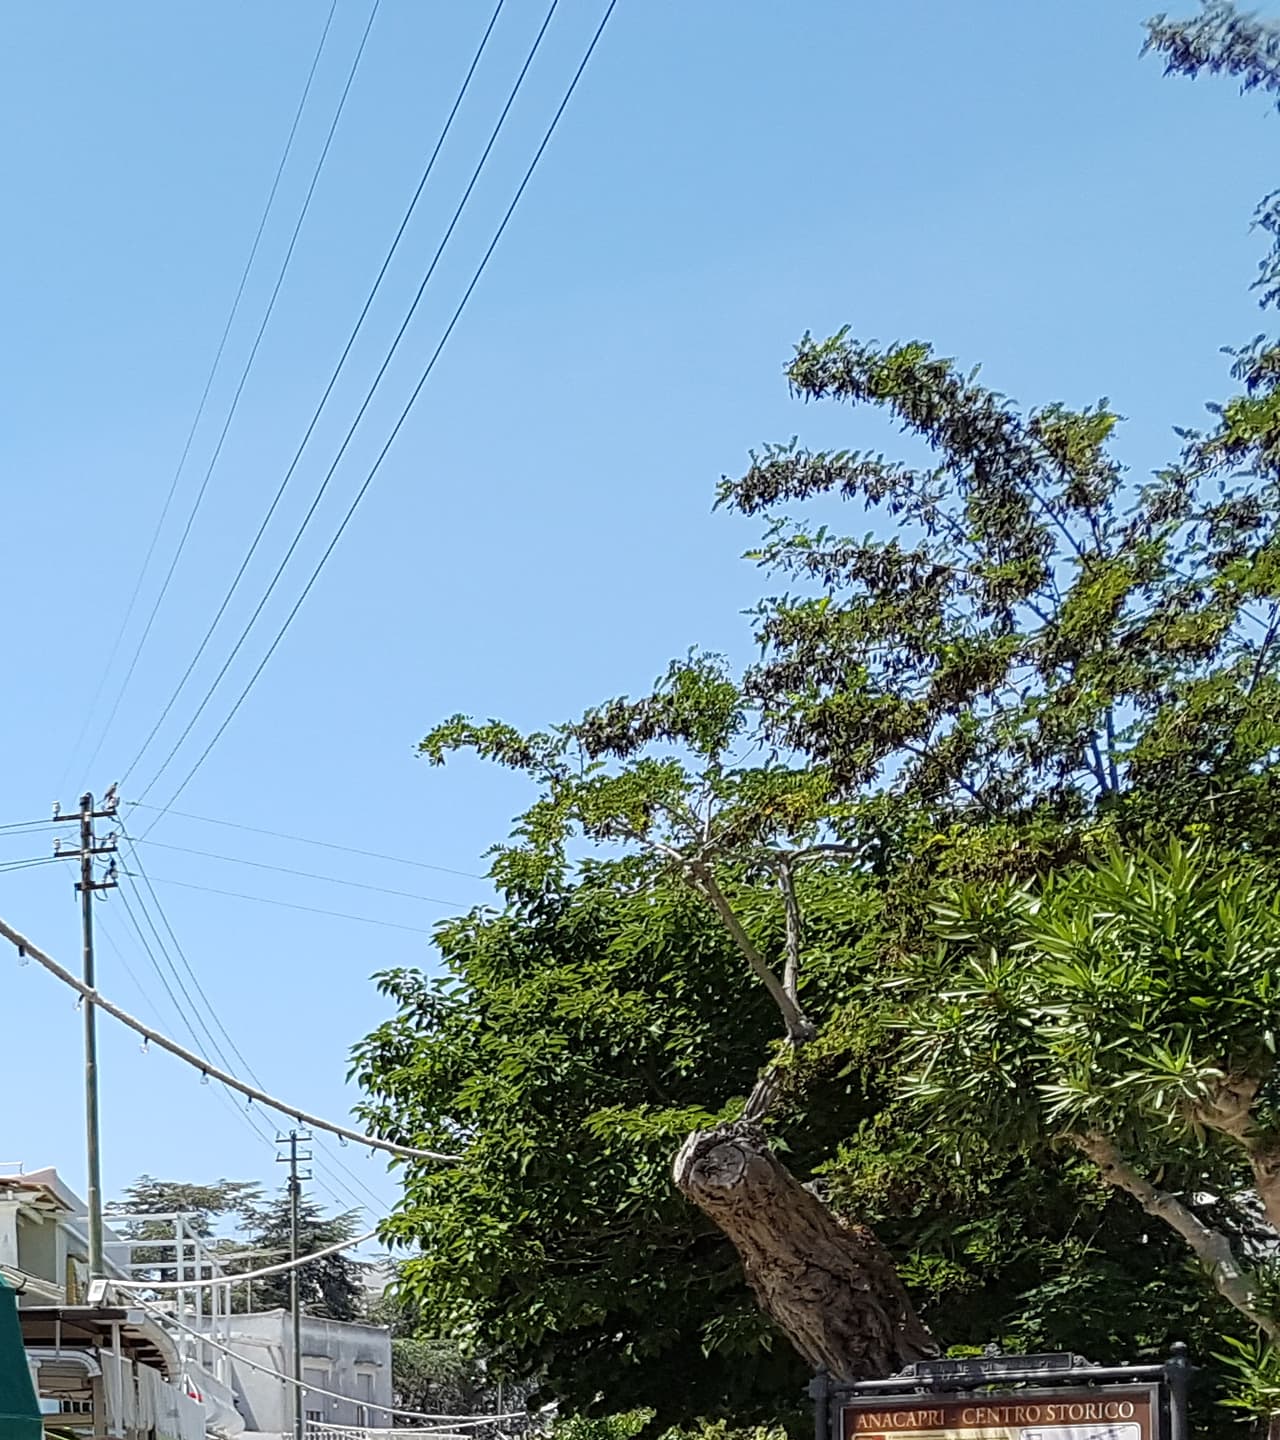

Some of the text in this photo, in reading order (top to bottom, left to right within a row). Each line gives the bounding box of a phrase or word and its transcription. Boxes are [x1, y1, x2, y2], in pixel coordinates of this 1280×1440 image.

[856, 1409, 945, 1429] ANACAPRI
[961, 1405, 1041, 1425] CENTRO
[1046, 1400, 1135, 1422] STORICO
